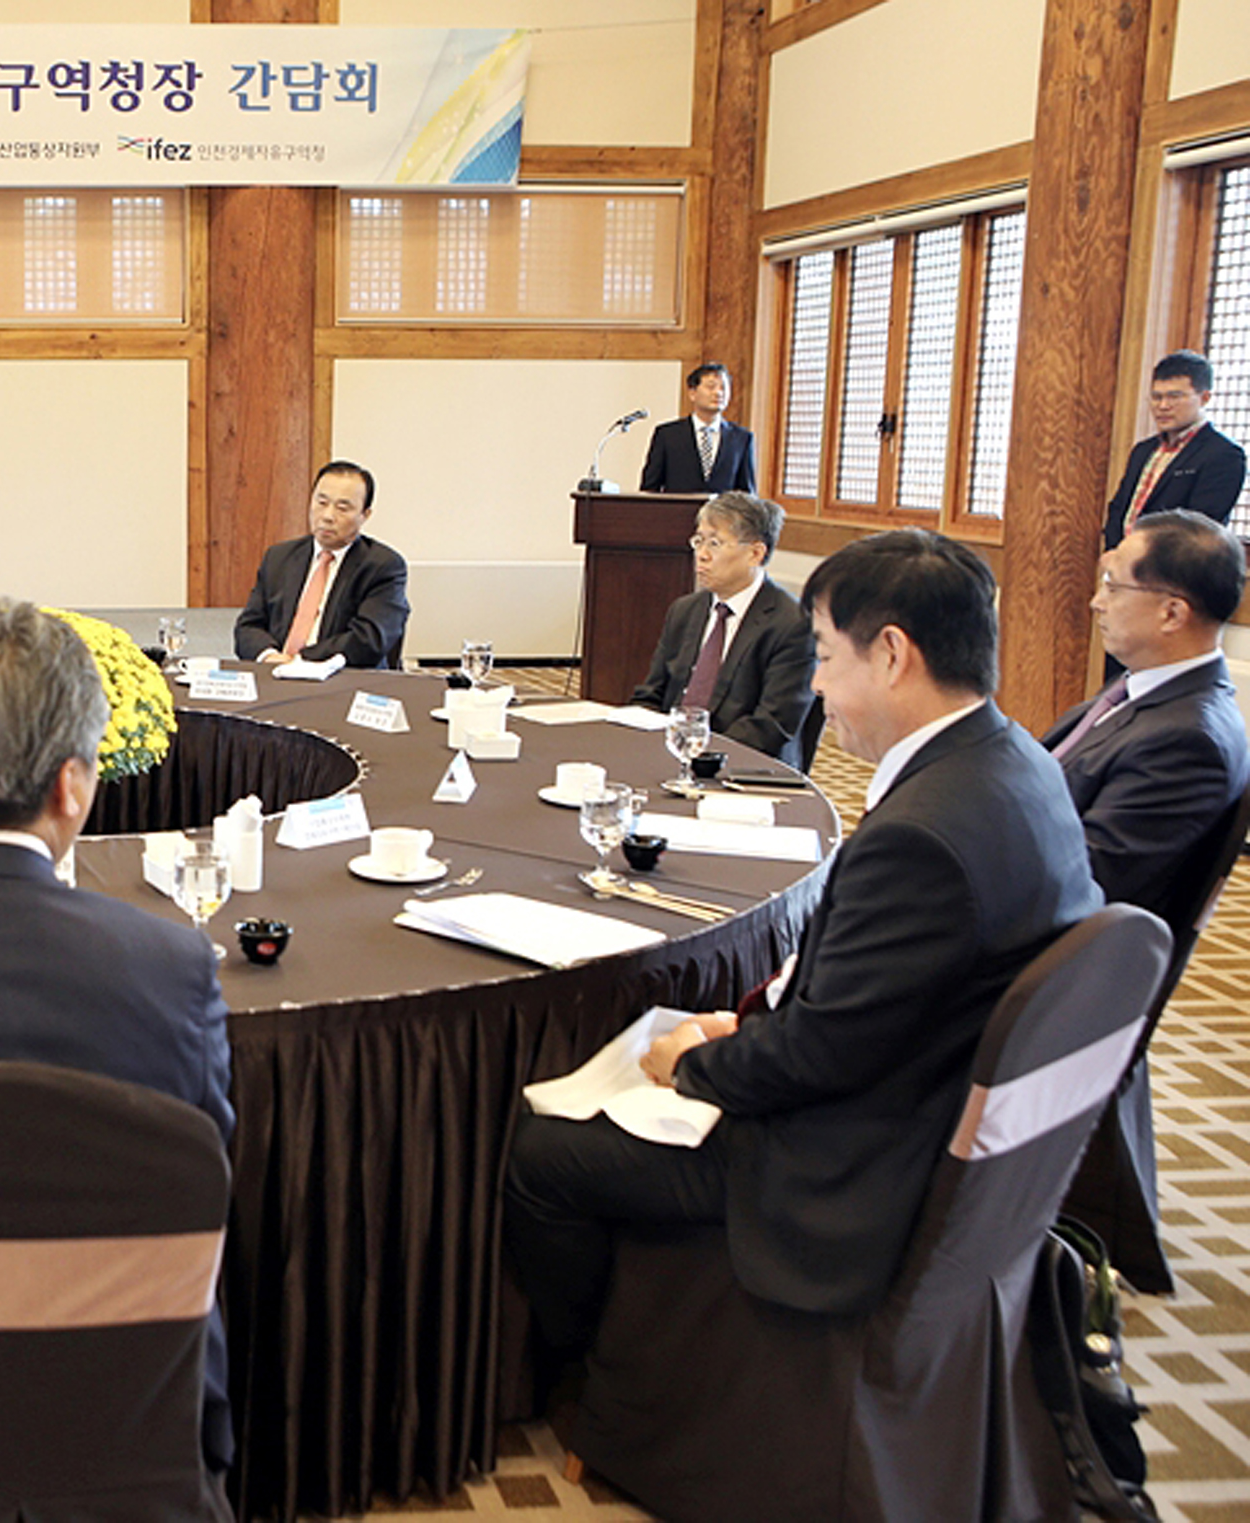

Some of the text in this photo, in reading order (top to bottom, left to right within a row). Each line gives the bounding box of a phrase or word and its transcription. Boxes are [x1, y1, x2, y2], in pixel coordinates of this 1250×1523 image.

[228, 61, 378, 114] 간담회
[0, 141, 101, 160] 산업통상자원부
[146, 137, 193, 162] ifez
[197, 144, 326, 162] 인천경제자유구역청
